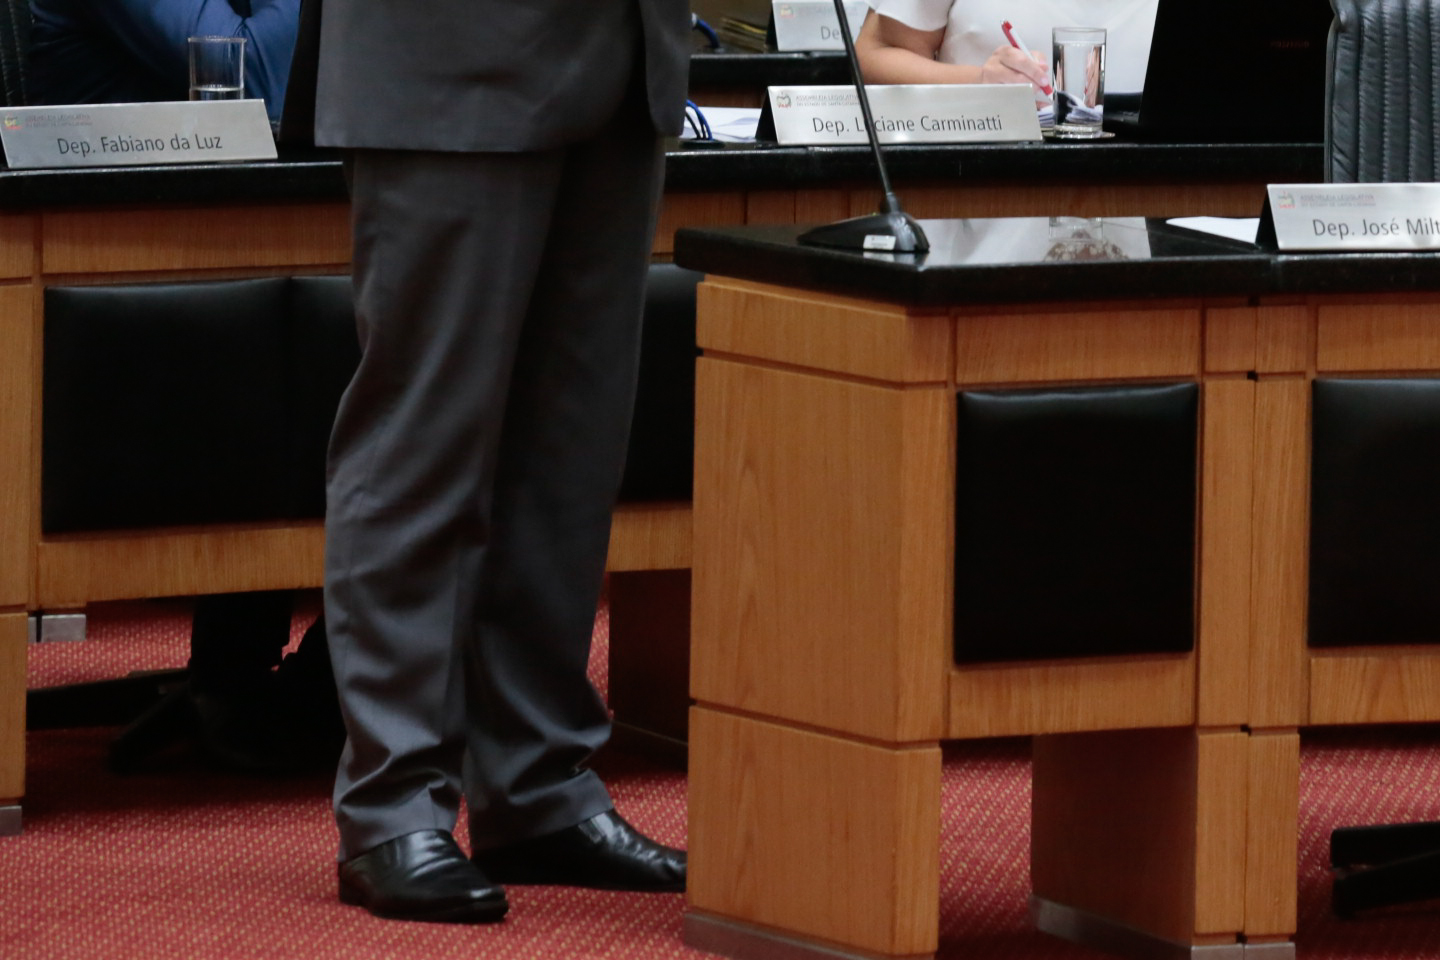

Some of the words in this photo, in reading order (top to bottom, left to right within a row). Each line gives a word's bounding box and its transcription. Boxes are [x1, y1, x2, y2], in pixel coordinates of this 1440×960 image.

[812, 117, 850, 136] Dep.
[855, 116, 915, 133] Lciane
[920, 115, 1002, 132] Carminatti
[57, 138, 96, 158] Dep.
[100, 135, 165, 153] Fabiano
[170, 133, 191, 151] da
[194, 133, 223, 150] Luz
[1312, 218, 1355, 240] Dep.
[1361, 217, 1400, 237] José
